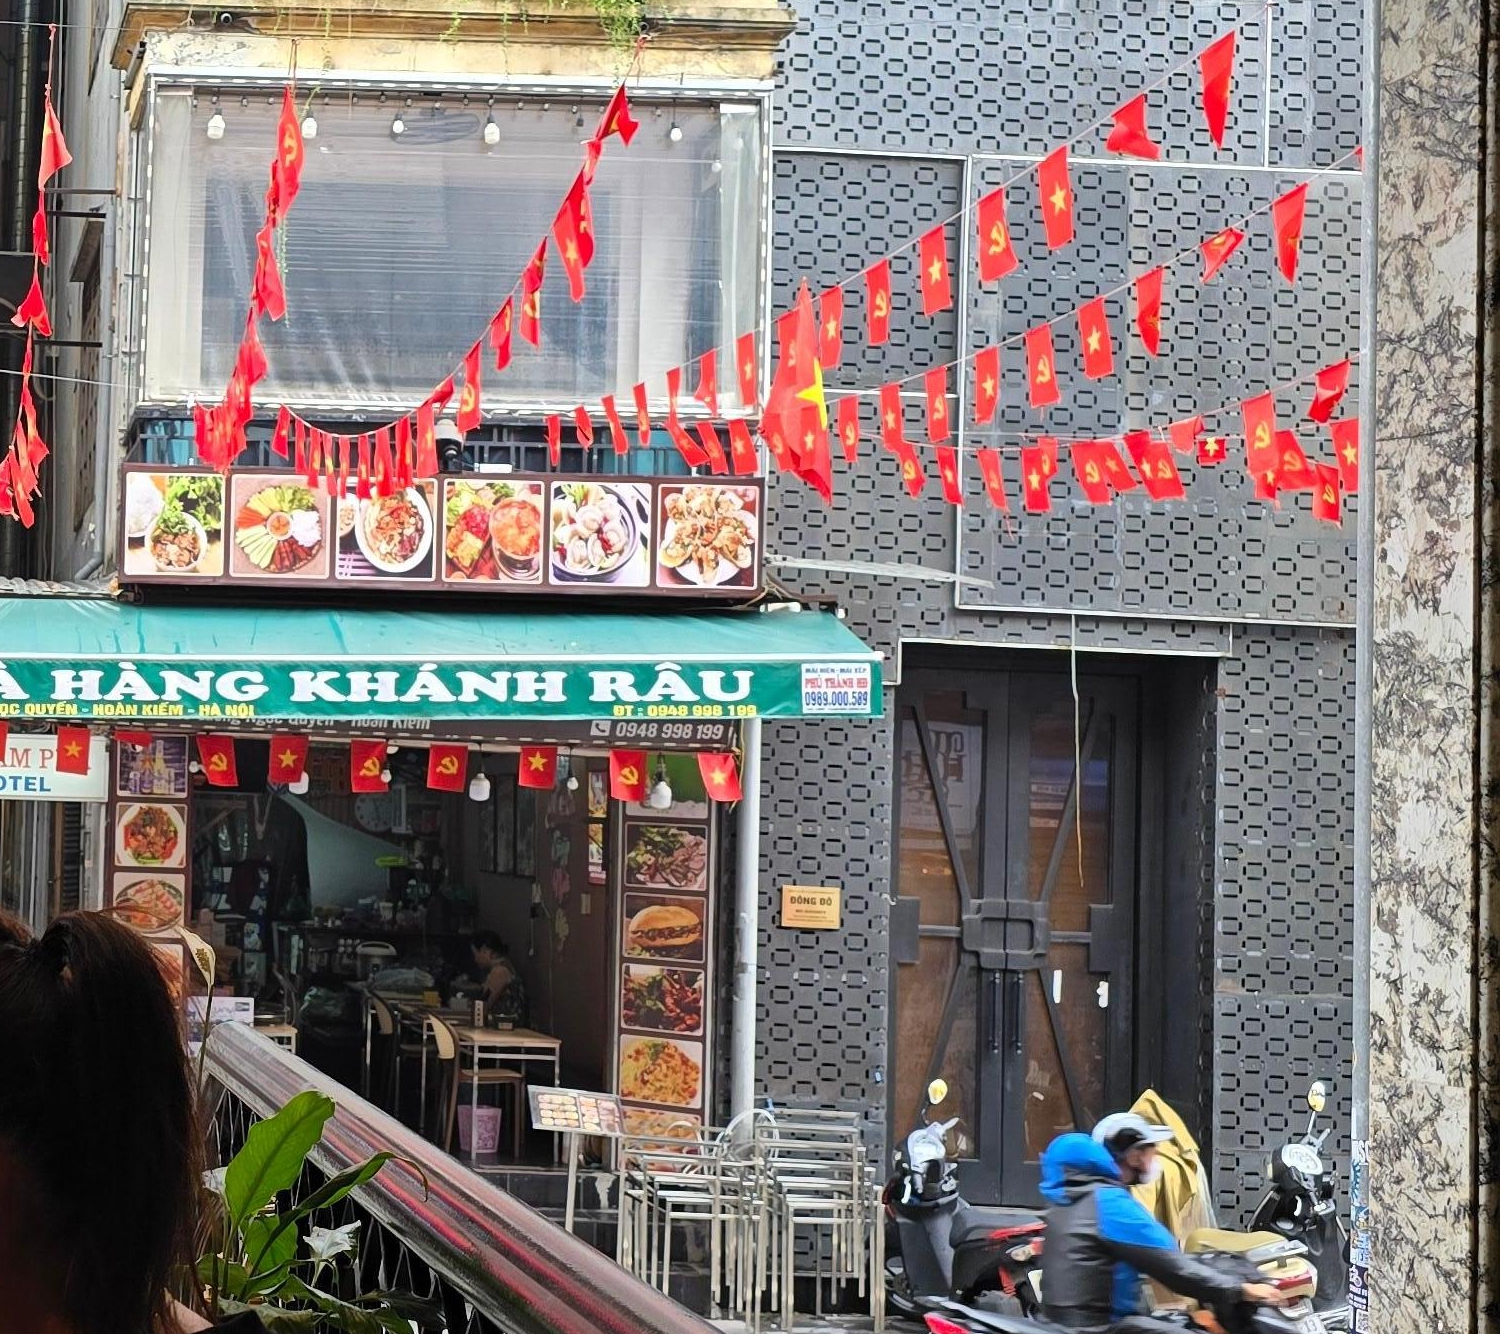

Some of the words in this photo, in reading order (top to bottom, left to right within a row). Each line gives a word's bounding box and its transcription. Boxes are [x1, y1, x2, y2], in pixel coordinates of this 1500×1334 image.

[50, 661, 269, 702] HÀNG
[289, 663, 567, 703] KHÁNH
[588, 661, 755, 703] RÂU
[805, 691, 868, 706] 0989.000.589
[25, 701, 78, 716] QUYẾN
[92, 701, 138, 716] HOÀN
[142, 700, 184, 716] KIẾM
[199, 702, 222, 717] HÀ
[225, 702, 254, 717] NỘI
[647, 705, 688, 717] 0948
[692, 705, 722, 717] 998
[727, 705, 757, 717] 199
[615, 721, 657, 738] 0948
[661, 722, 693, 740] 998
[696, 723, 723, 740] 199
